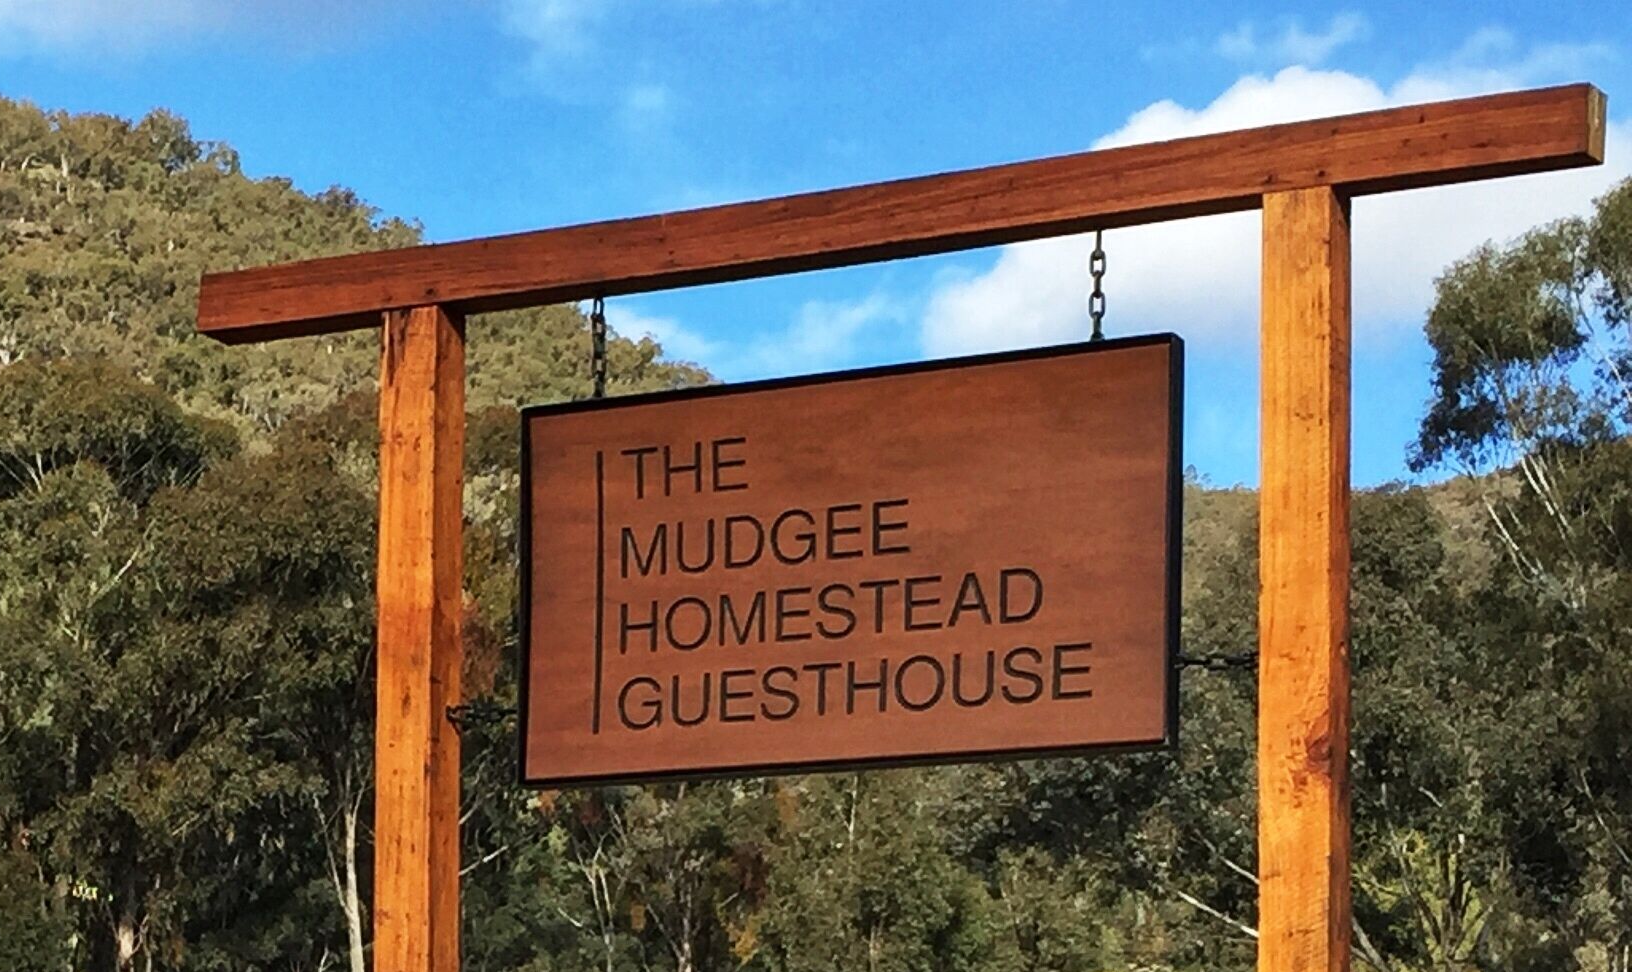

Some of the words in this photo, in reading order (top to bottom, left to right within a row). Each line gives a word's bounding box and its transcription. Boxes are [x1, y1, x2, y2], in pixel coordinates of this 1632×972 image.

[621, 437, 748, 499] THE
[620, 499, 911, 579] MUDGEE
[620, 567, 1044, 655] HOMESTEAD
[618, 642, 1093, 731] GUESTHOUSE
